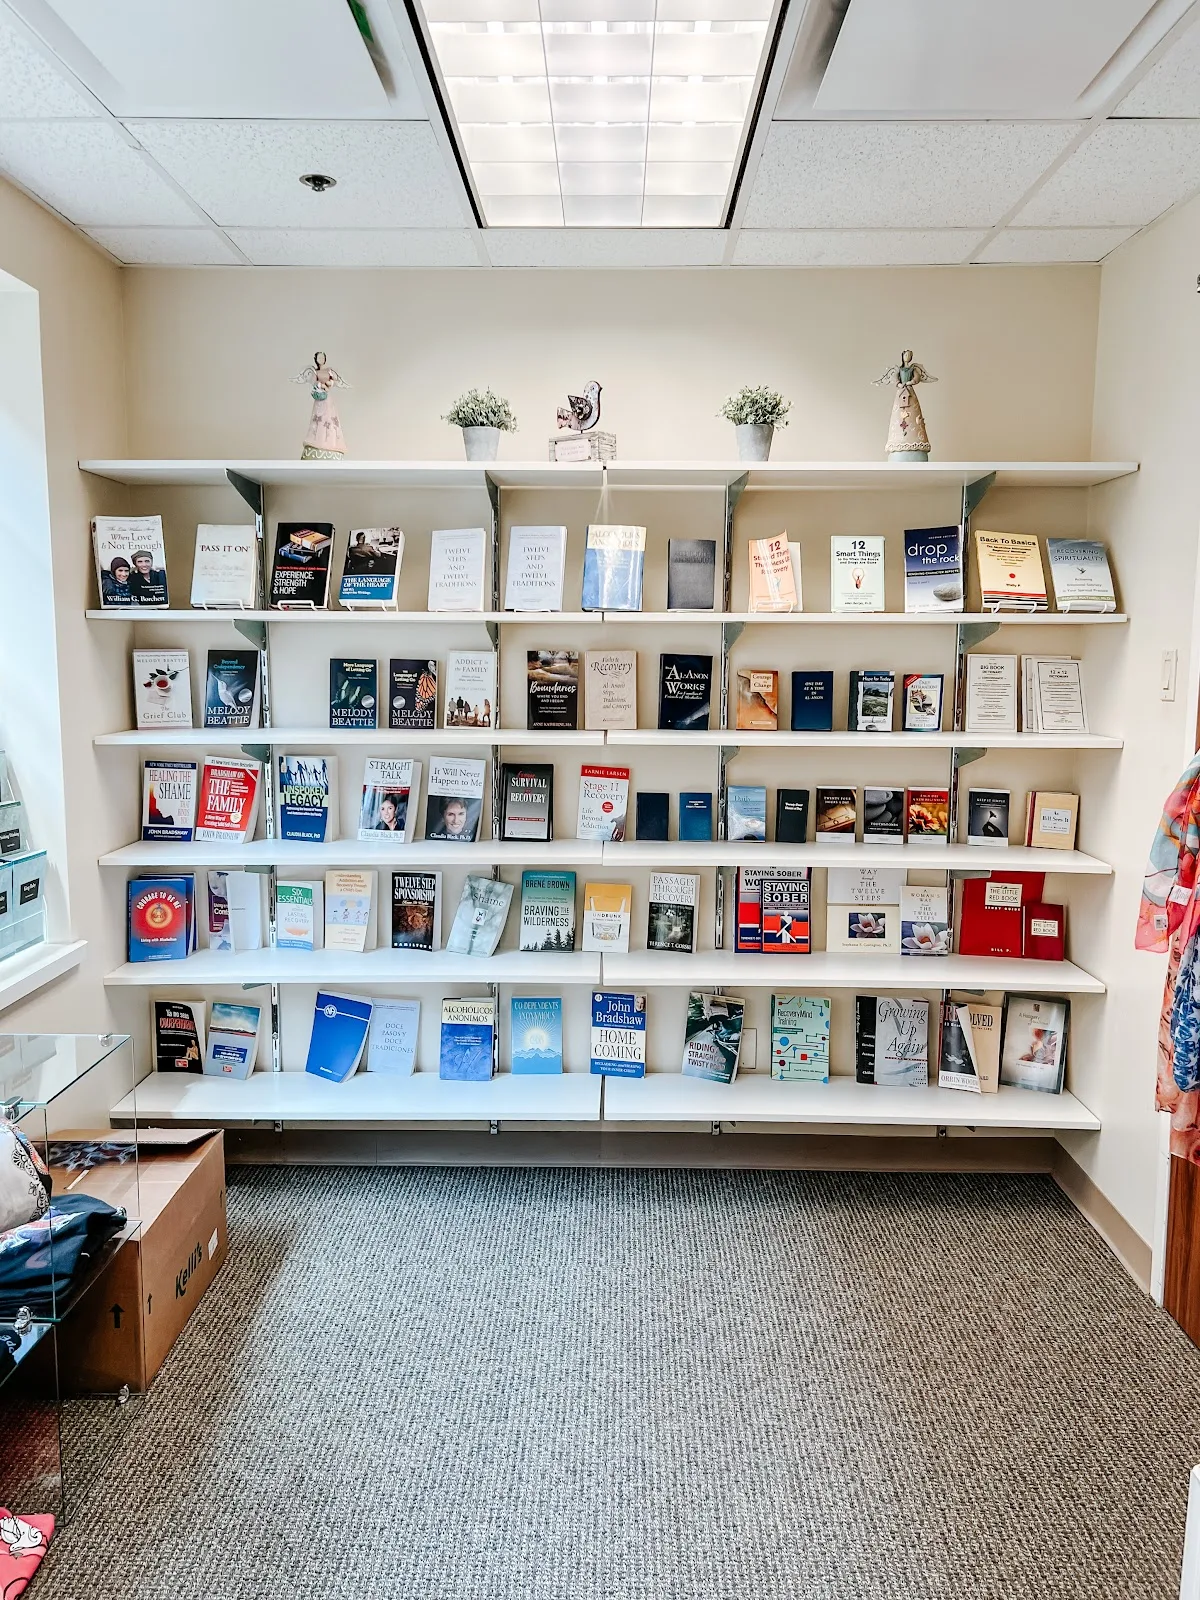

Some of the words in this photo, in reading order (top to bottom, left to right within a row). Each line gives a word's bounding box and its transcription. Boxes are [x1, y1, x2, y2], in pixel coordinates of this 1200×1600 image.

[131, 532, 151, 540] Love
[108, 542, 126, 550] Not
[128, 542, 162, 551] Enough
[769, 541, 781, 552] 12
[851, 541, 865, 549] 12
[908, 543, 947, 558] drop
[940, 554, 959, 563] rock
[274, 579, 307, 587] STRENGTH
[590, 662, 633, 674] Recovery
[530, 681, 576, 693] Boundaries
[207, 706, 250, 714] MELODY
[332, 709, 374, 717] MELODY
[207, 716, 250, 724] BEATTIE
[332, 718, 374, 726] BEATTIE
[392, 718, 433, 726] BEATTIE
[369, 761, 411, 770] STRAIGHT
[150, 770, 178, 782] HEALING
[179, 770, 191, 783] THE
[210, 769, 235, 777] BRADSHAW
[381, 771, 401, 779] TALK
[442, 768, 458, 776] Will
[460, 769, 480, 778] Never
[431, 776, 459, 786] Happen
[511, 777, 547, 788] SURVIVAL
[584, 780, 607, 792] Stage
[159, 783, 191, 799] SHAME
[210, 779, 230, 795] THE
[284, 785, 324, 795] UNSPOKEN
[284, 794, 324, 806] LEGACY
[510, 792, 545, 804] RECOVERY
[584, 790, 625, 803] Recovery
[207, 795, 246, 813] FAMILY
[581, 822, 609, 830] Addiction
[395, 876, 420, 888] TWELVE
[422, 878, 435, 890] STEP
[547, 881, 570, 889] BROWN
[653, 876, 694, 886] PASSAGES
[292, 888, 302, 896] SIX
[654, 885, 694, 895] THROUGH
[764, 883, 808, 892] STAYING
[394, 888, 435, 901] SPONSORSHIP
[473, 893, 504, 906] Shame
[653, 893, 692, 903] RECOVERY
[764, 894, 808, 902] SOBER
[137, 892, 158, 910] COURAGE
[168, 894, 175, 902] BE
[173, 900, 181, 909] ME
[278, 895, 313, 906] ESSENTIALS
[525, 906, 559, 916] BRAVING
[524, 917, 569, 927] WILDERNESS
[444, 1006, 493, 1015] ALCOHÓLICOS
[607, 1000, 630, 1013] John
[166, 1009, 172, 1017] Ya
[519, 1012, 555, 1020] ANONYMOUS
[778, 1009, 812, 1018] RecoveryMind
[879, 1001, 927, 1024] Growing
[596, 1012, 643, 1025] Bradshaw
[778, 1018, 797, 1026] Training
[901, 1021, 917, 1042] Up
[600, 1030, 636, 1045] HOME
[372, 1044, 414, 1053] TRADICIONES
[690, 1042, 715, 1053] RIDING
[887, 1036, 927, 1057] Again
[594, 1044, 641, 1060] COMING
[688, 1050, 716, 1062] STRAIGHT
[688, 1059, 709, 1068] TWISTY
[710, 1062, 726, 1070] ROAD
[176, 1242, 202, 1300] Kelli's
